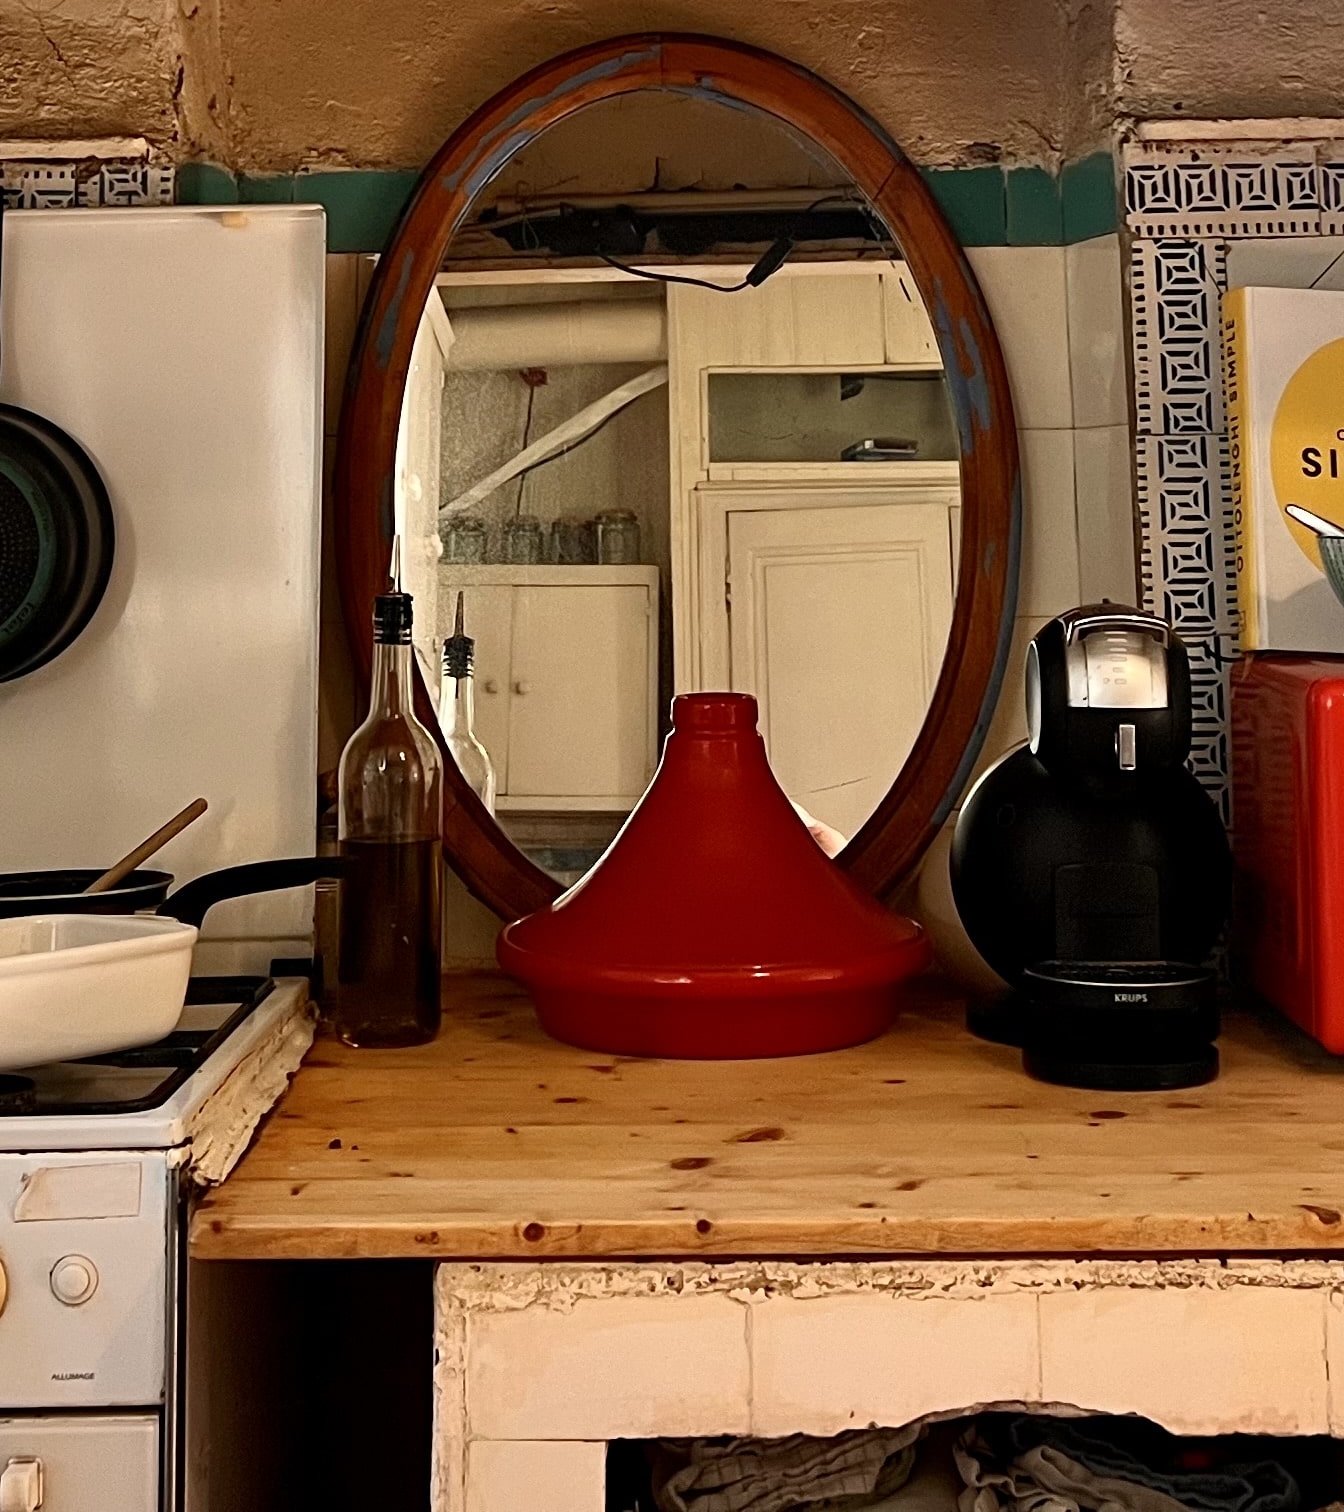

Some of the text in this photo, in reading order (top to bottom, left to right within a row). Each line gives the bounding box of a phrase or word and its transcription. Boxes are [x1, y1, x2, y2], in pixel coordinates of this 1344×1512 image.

[1225, 318, 1244, 573] OTTOLENGHI SIMPLE
[1114, 993, 1148, 1003] KRUPS
[51, 1372, 95, 1380] ALLUMAGE
